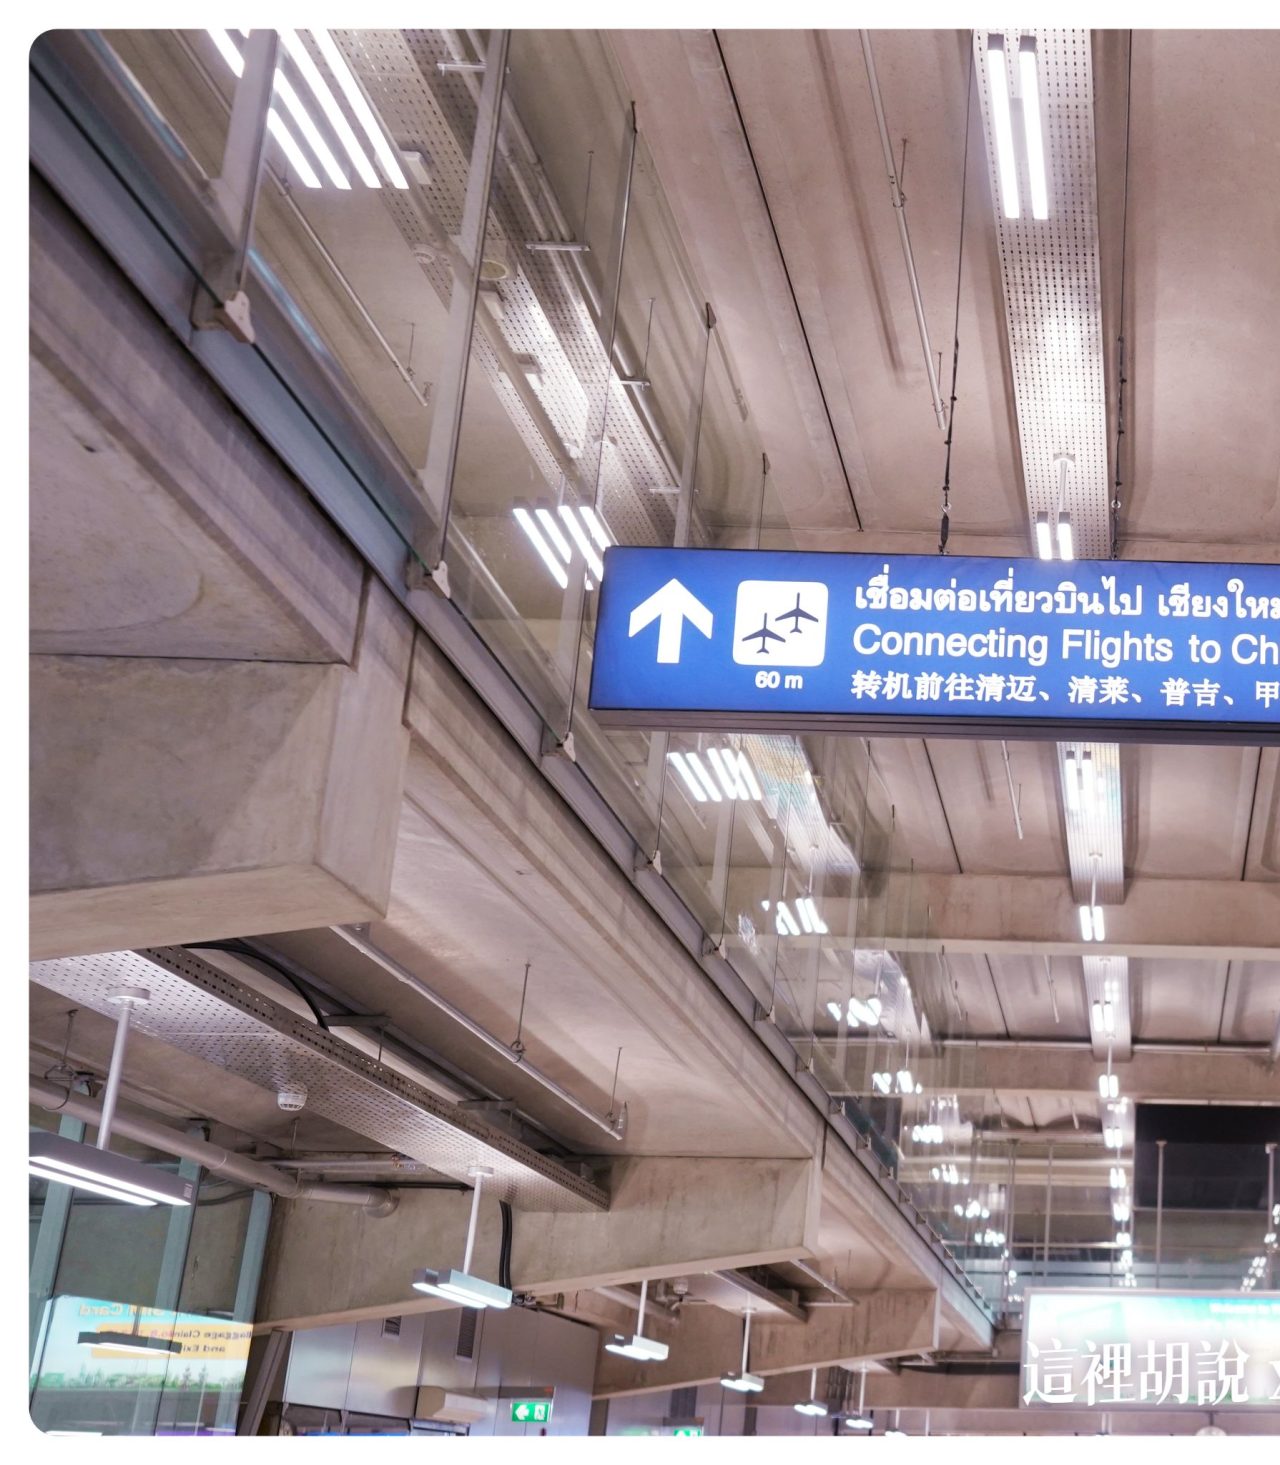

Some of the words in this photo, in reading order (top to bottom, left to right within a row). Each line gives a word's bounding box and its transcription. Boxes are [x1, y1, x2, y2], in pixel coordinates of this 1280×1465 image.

[856, 564, 1142, 617] เชื่อมต่อเที่ยวบินไป
[853, 623, 1048, 667] Connecting
[1062, 629, 1173, 669] Flights
[1188, 635, 1222, 664] to
[755, 671, 780, 689] 60
[785, 674, 804, 690] m
